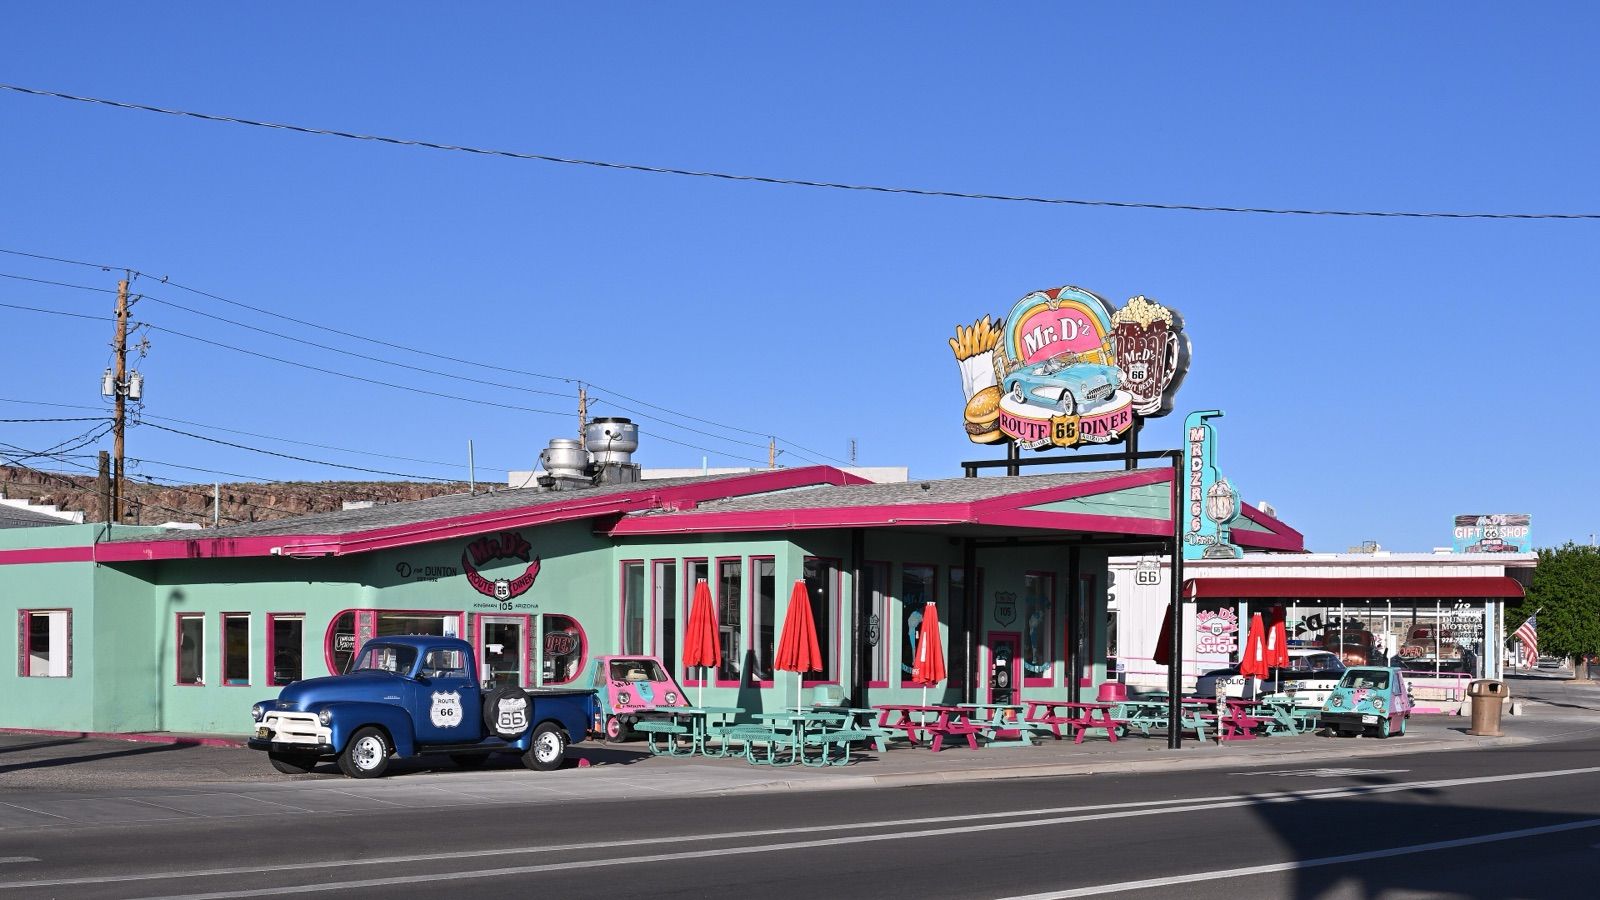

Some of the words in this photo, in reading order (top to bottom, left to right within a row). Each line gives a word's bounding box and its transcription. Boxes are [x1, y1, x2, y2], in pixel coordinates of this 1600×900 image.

[1023, 326, 1058, 357] Mr.
[1060, 318, 1091, 340] D'z
[1124, 350, 1142, 364] Mr.
[1131, 370, 1144, 380] 66
[1001, 415, 1047, 440] ROUTE
[1055, 421, 1076, 438] 66
[1081, 410, 1128, 435] DINER
[1454, 526, 1482, 539] GIFT
[1485, 530, 1497, 538] 66
[1500, 526, 1529, 538] SHOP
[425, 566, 457, 577] DUNTON
[1139, 571, 1157, 583] 66
[470, 572, 495, 592] ROUTE
[497, 586, 507, 595] 66
[512, 573, 534, 592] DINER
[499, 602, 513, 611] 105
[545, 635, 572, 653] OPEN
[1201, 636, 1238, 645] GIFT
[1196, 644, 1238, 653] SHOP
[1400, 648, 1421, 657] OPEN
[440, 708, 454, 716] 66
[500, 711, 524, 726] 66
